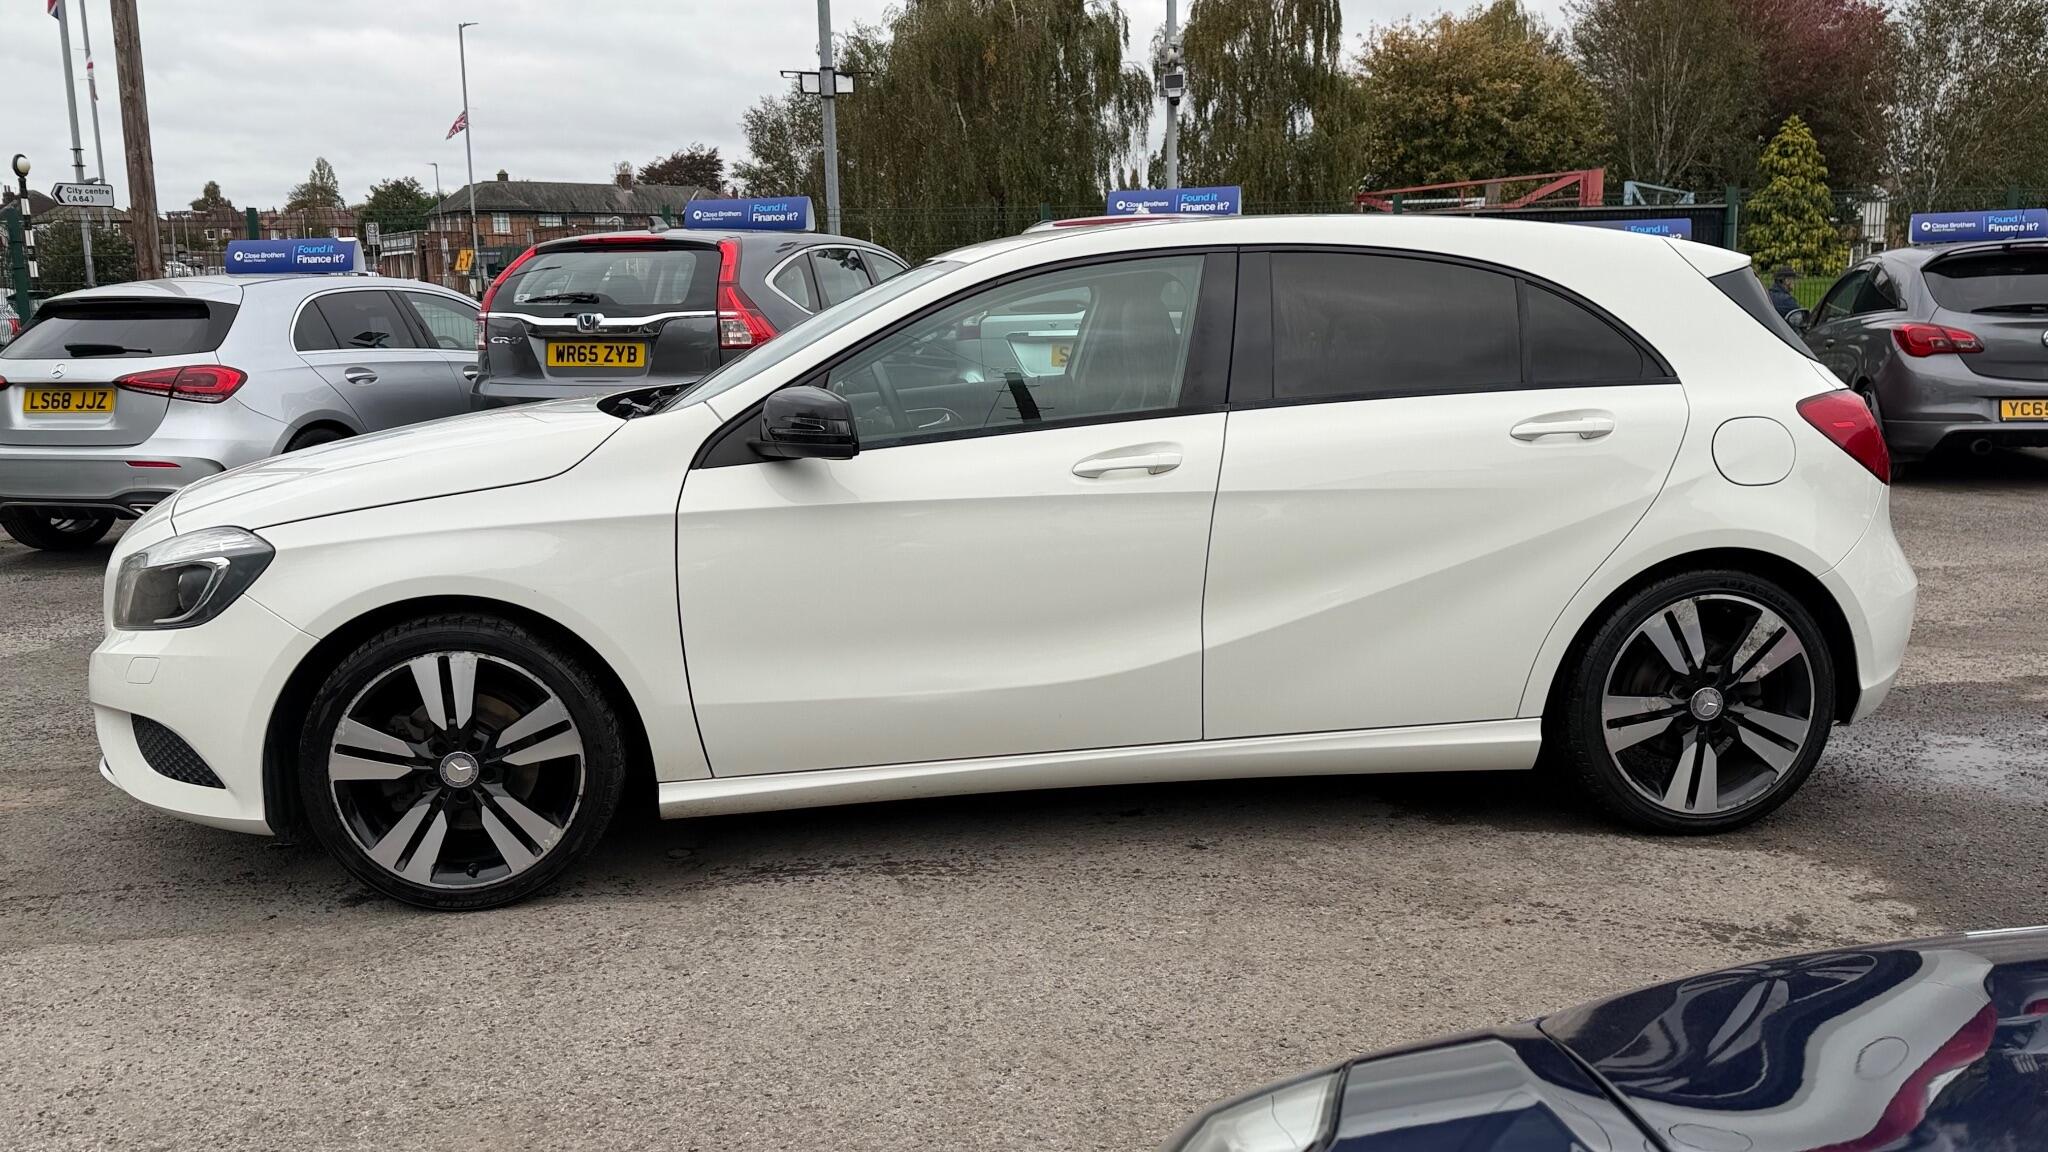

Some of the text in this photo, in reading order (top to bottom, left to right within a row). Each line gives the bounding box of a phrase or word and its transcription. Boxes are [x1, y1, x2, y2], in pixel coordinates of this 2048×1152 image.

[67, 195, 94, 203] (A64)
[1181, 194, 1210, 202] Found
[753, 204, 780, 212] Found
[1180, 202, 1229, 211] Finance it?
[753, 212, 798, 222] Finance it?
[1988, 215, 2017, 223] Found
[1631, 225, 1669, 233] Found it
[1988, 223, 2039, 232] Finance it?
[297, 245, 333, 254] Found it
[296, 254, 345, 264] Finance it?
[556, 345, 637, 363] WR65 ZYB
[30, 392, 107, 409] LS68 JJZ
